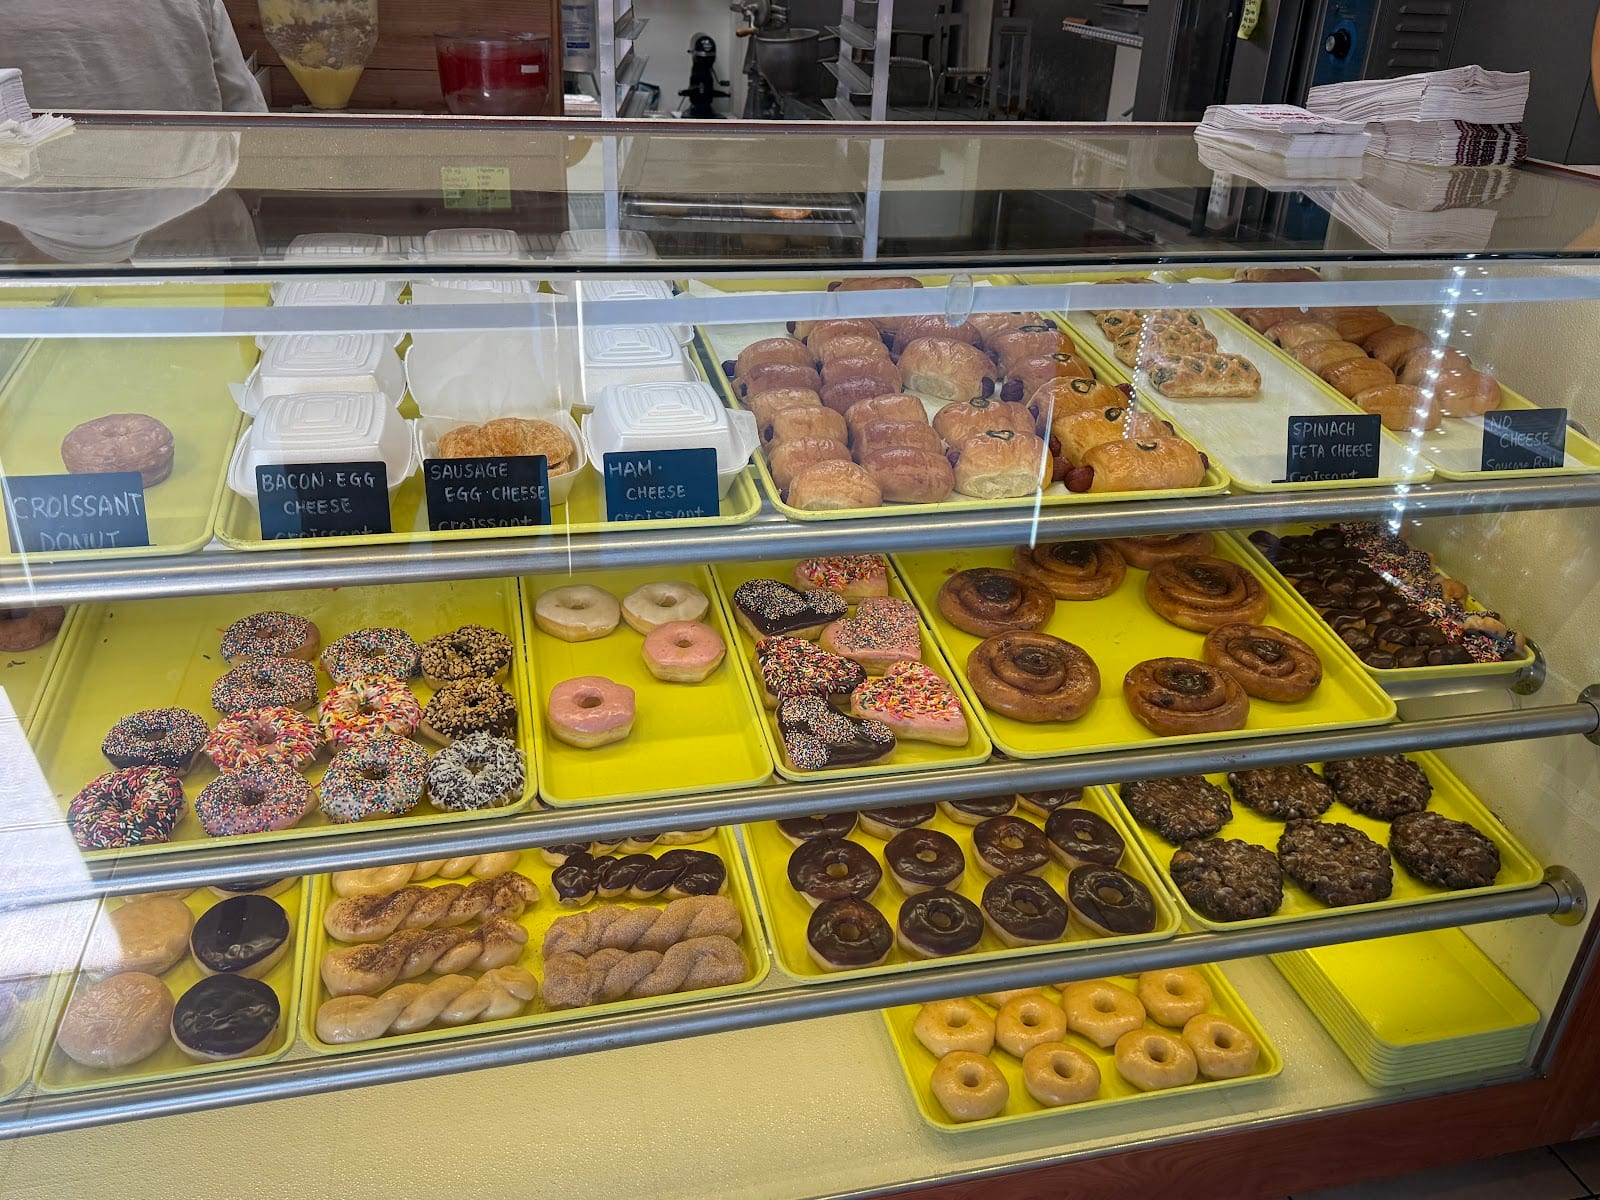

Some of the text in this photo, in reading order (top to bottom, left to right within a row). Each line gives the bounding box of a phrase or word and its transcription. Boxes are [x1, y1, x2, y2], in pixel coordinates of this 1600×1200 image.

[1293, 421, 1355, 437] SPINACH
[1490, 415, 1512, 431] NO
[1500, 432, 1550, 448] CHEESE
[1291, 443, 1374, 459] FETA CHEESE
[430, 463, 508, 480] SAUSAGE
[609, 460, 652, 478] HAM
[261, 471, 376, 492] BACON EGG
[445, 486, 547, 502] EGG CHEESE
[626, 485, 686, 500] CHEESE
[13, 491, 142, 519] CROISSANT
[284, 498, 352, 515] CHEESE
[40, 530, 120, 551] DONUT
